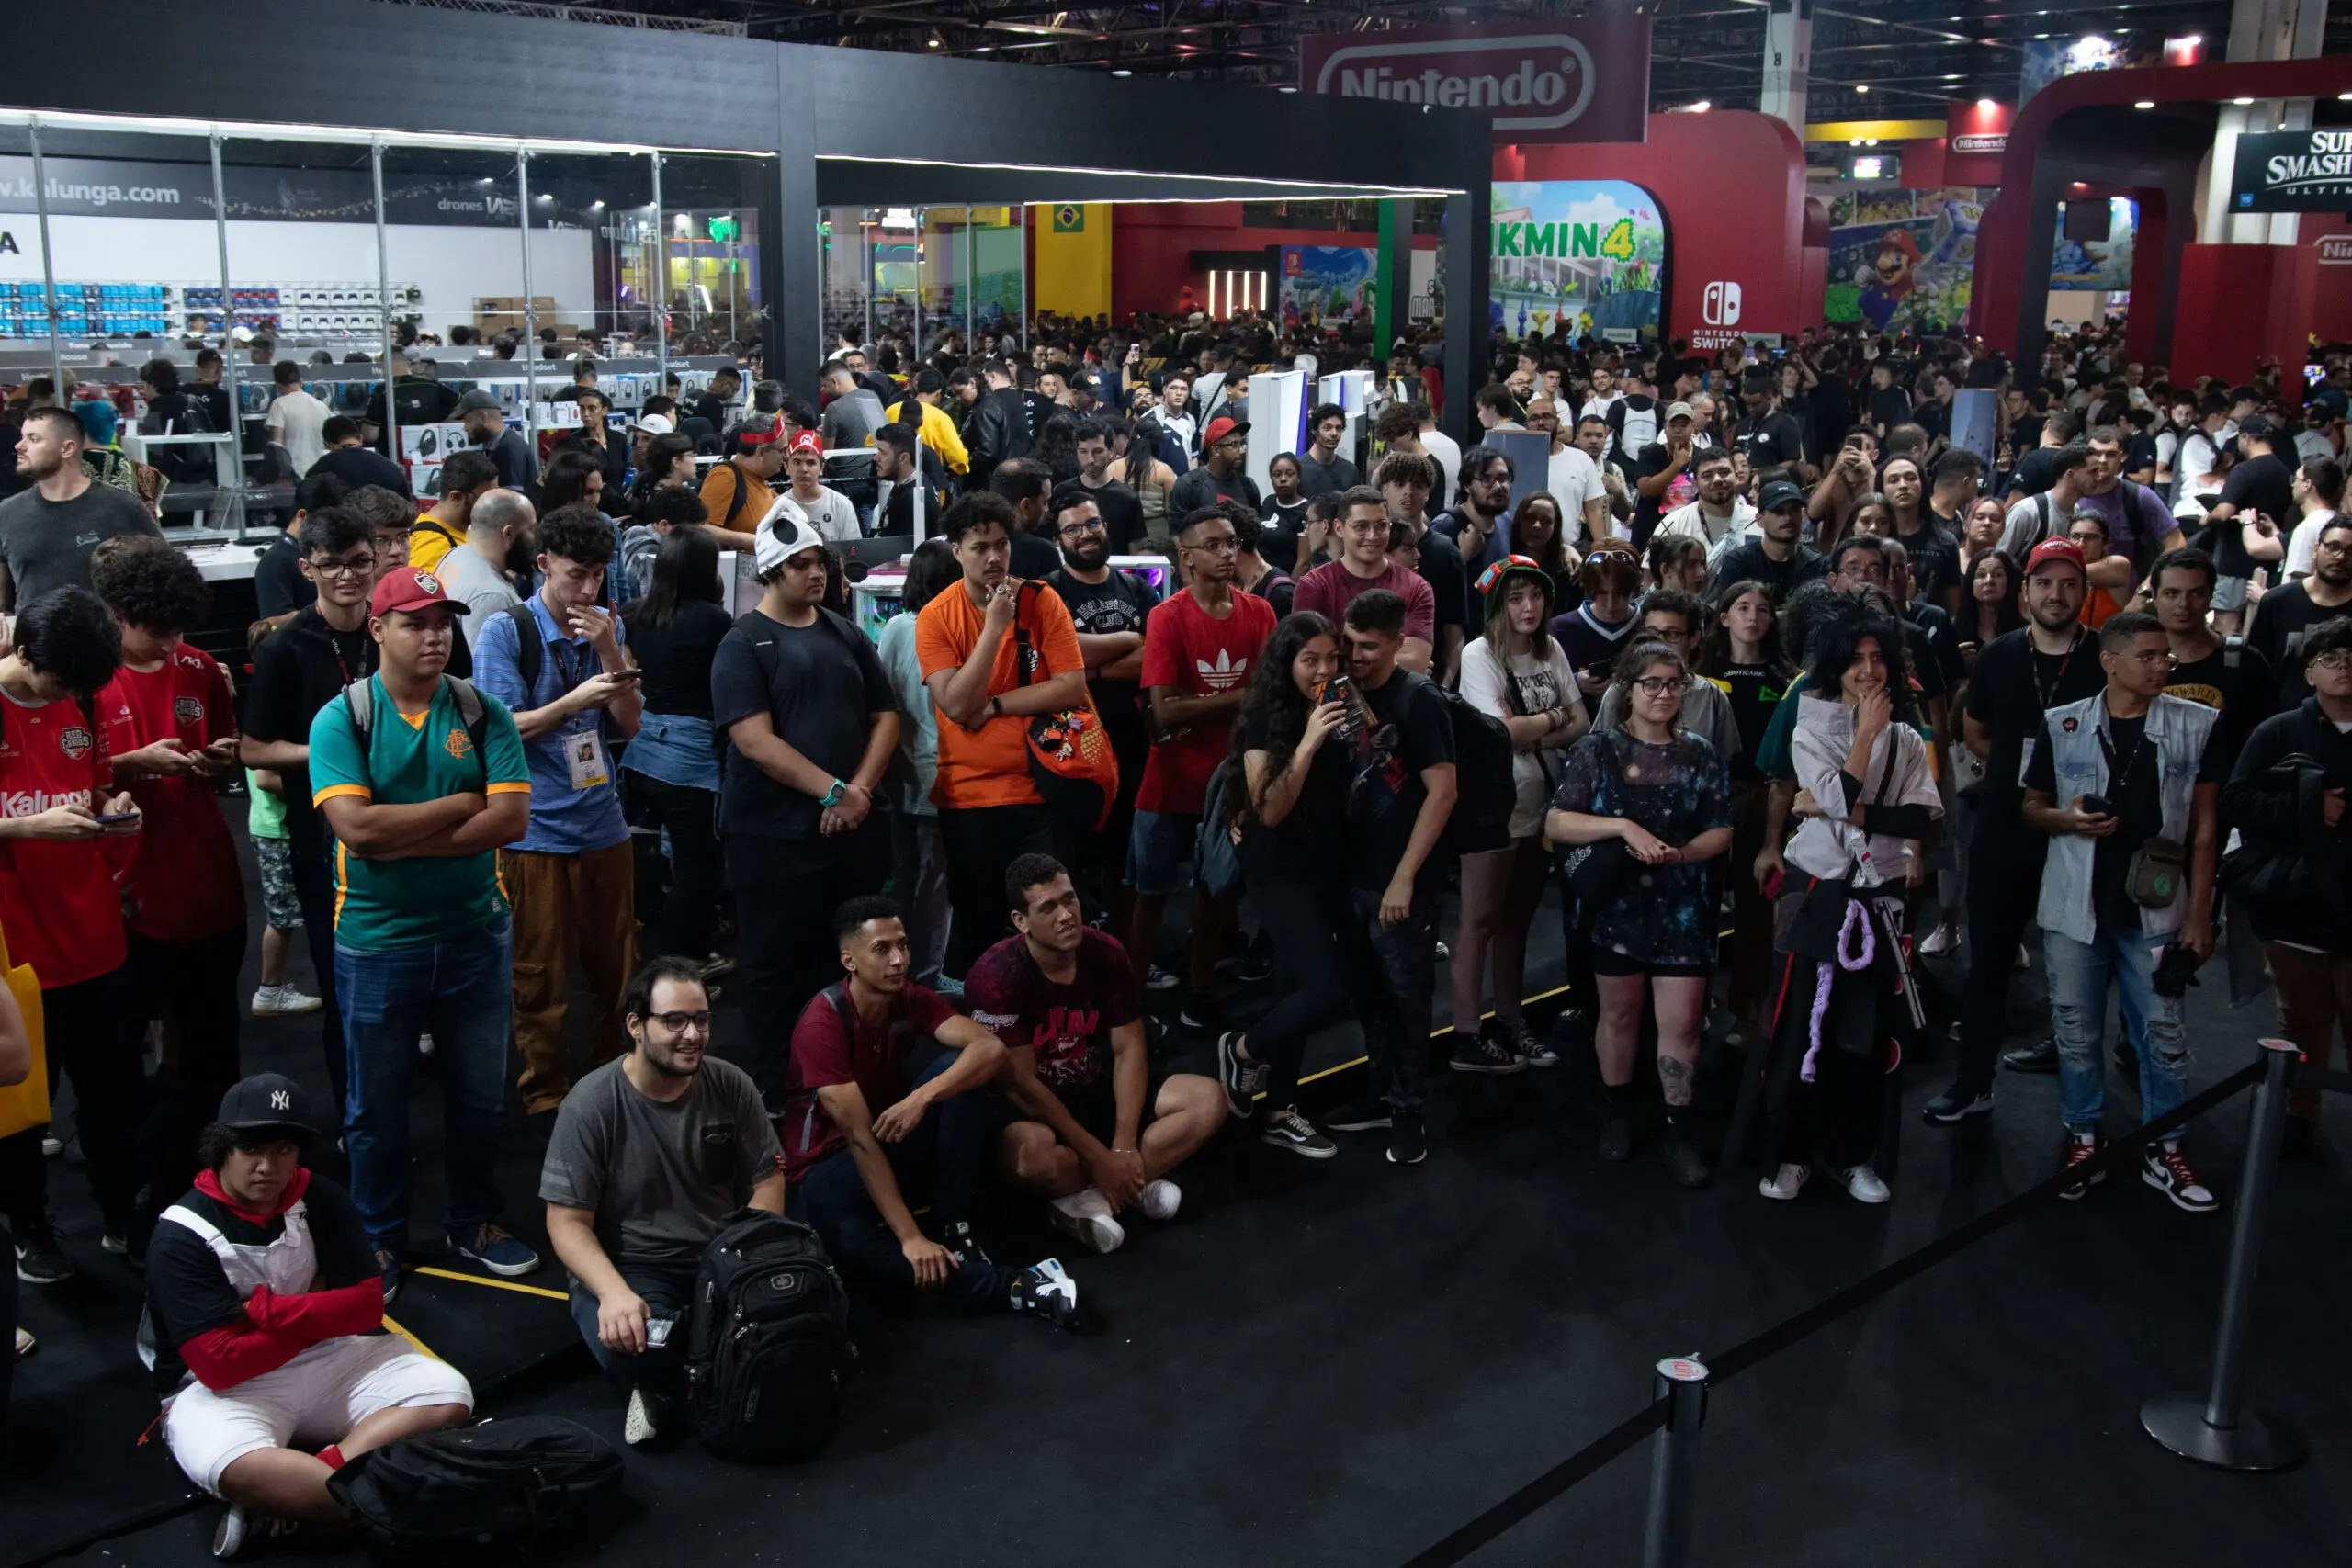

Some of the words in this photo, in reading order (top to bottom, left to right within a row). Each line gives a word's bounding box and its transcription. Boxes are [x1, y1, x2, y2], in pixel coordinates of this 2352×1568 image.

[1773, 52, 1781, 66] 8
[437, 197, 483, 212] drones
[1095, 612, 1124, 628] CLUB
[65, 729, 82, 739] RED
